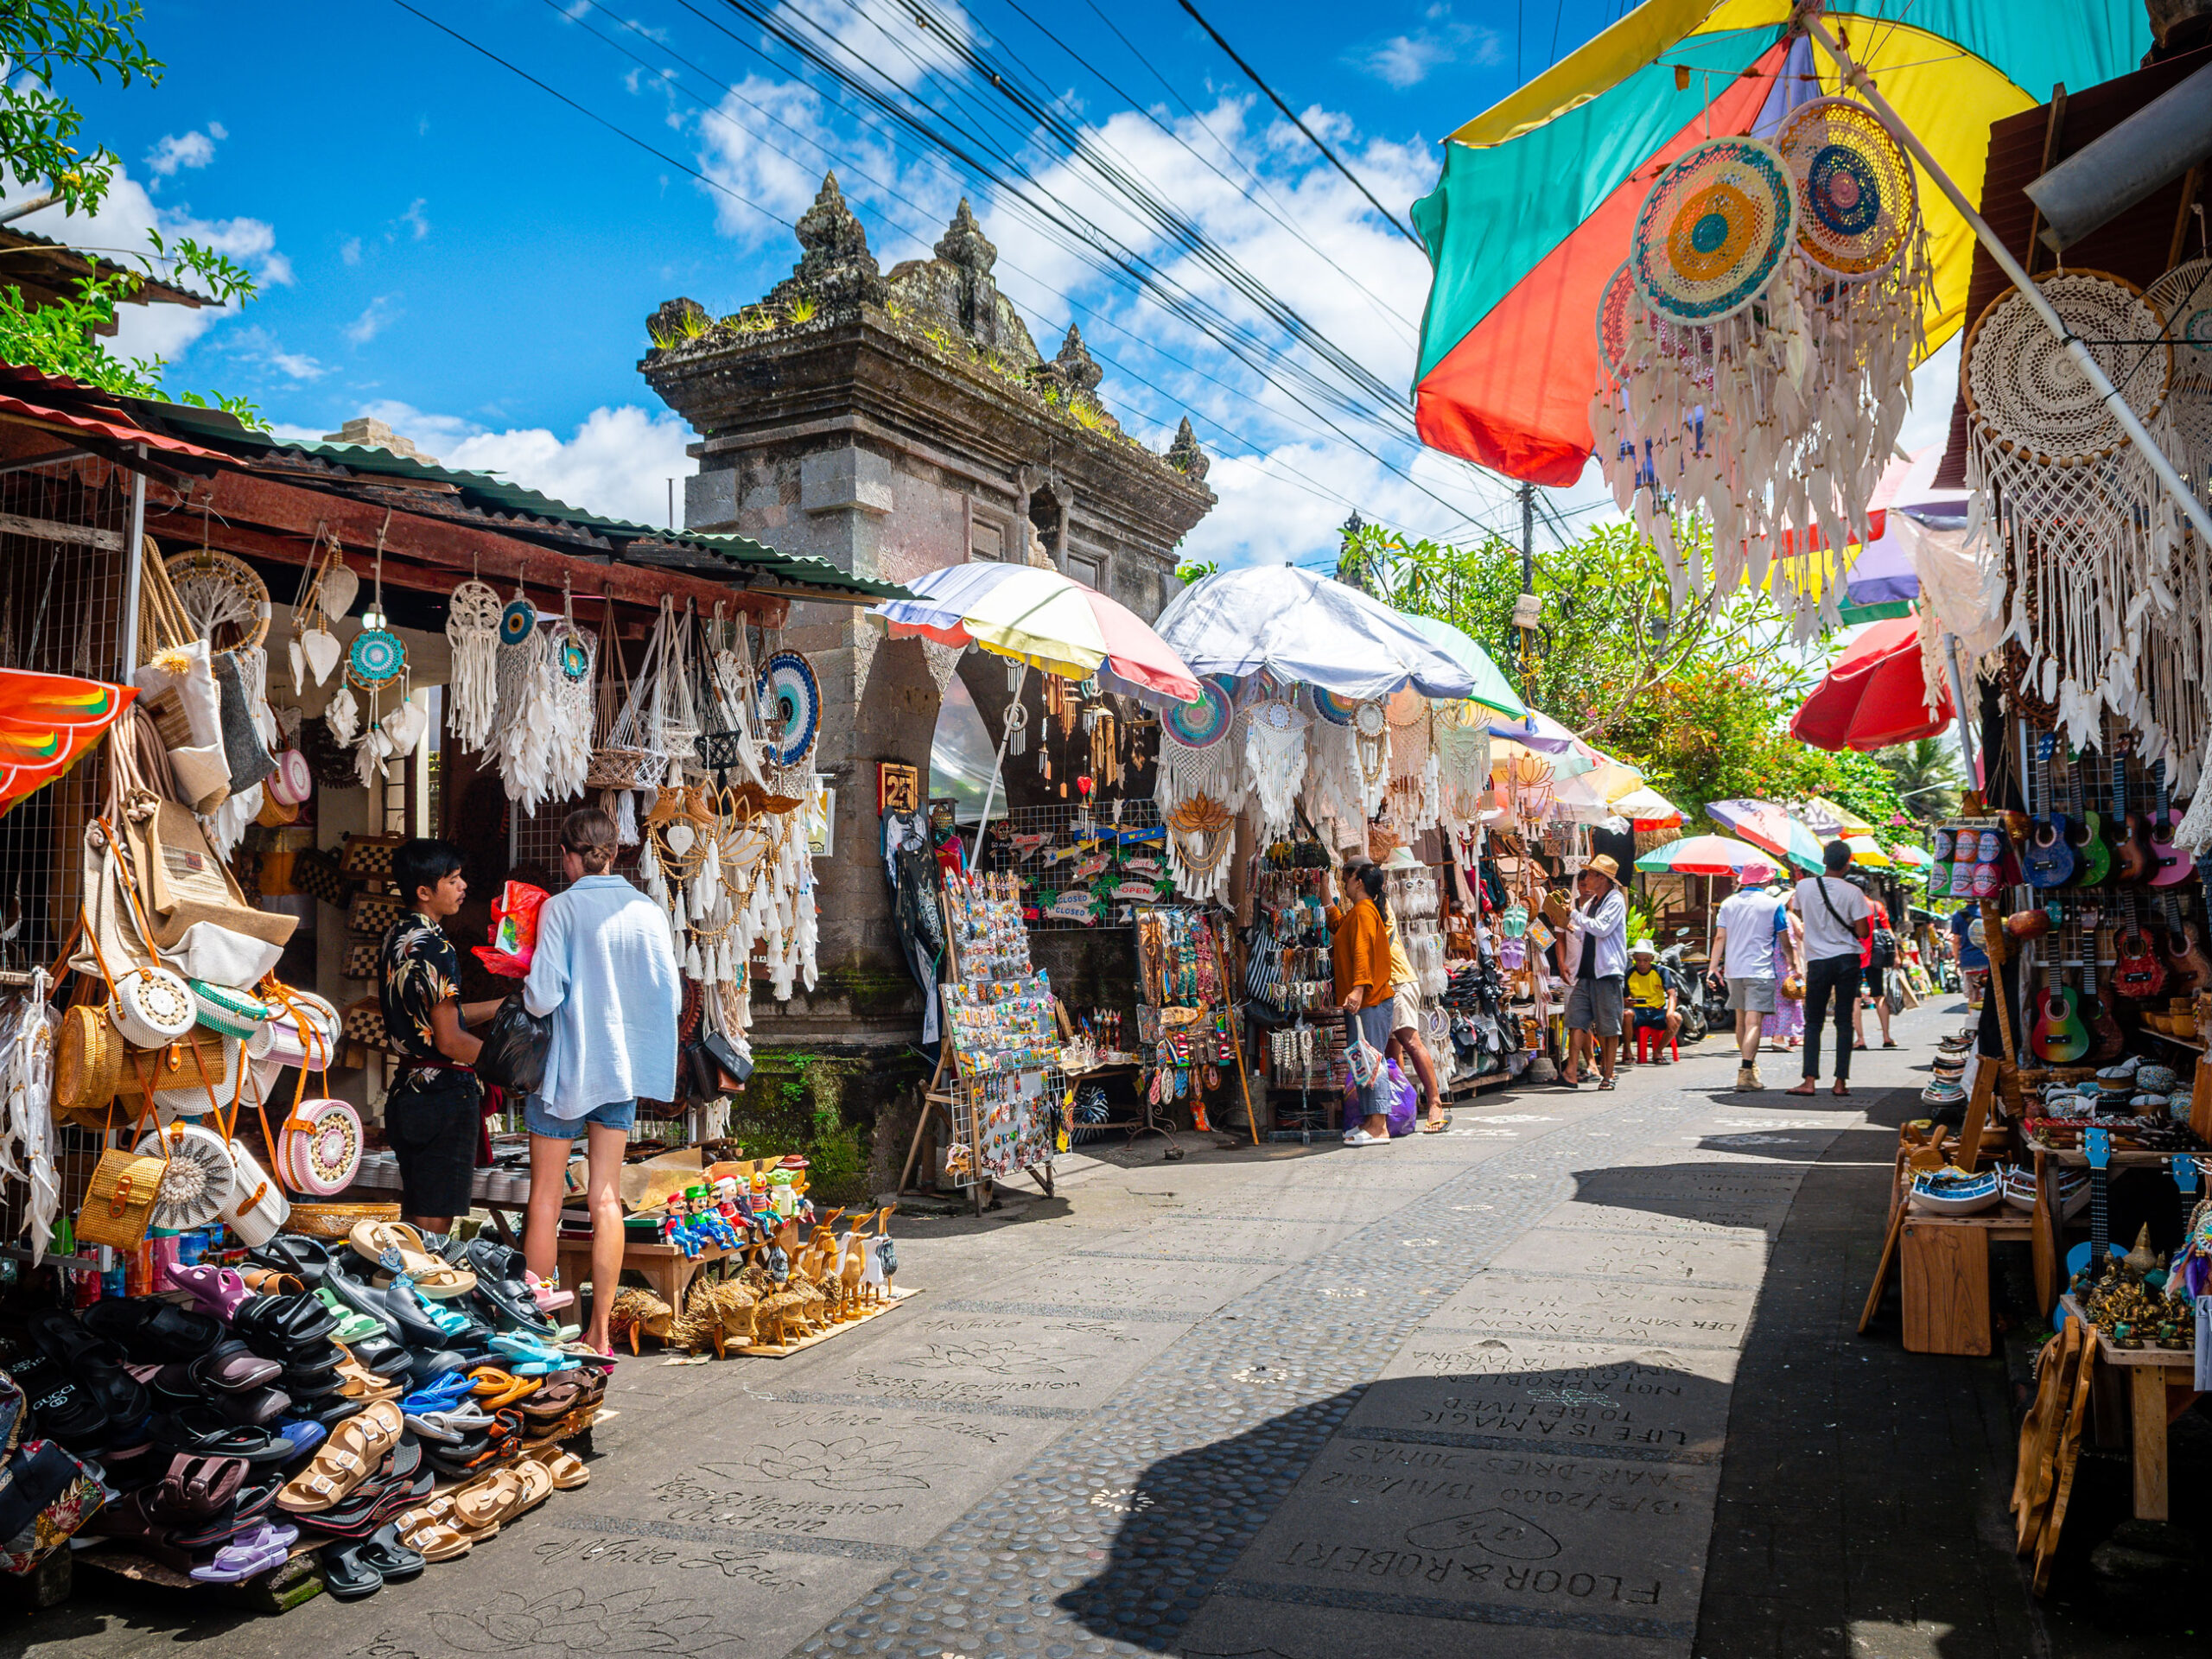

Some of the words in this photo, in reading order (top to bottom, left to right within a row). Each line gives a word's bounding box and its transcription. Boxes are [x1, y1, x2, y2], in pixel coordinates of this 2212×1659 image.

[1122, 887, 1150, 895] OPEN
[1058, 894, 1088, 904] CLOSED
[1055, 906, 1085, 917] CLOSED
[33, 1384, 76, 1410] GUCCI
[1443, 1398, 1537, 1416] LIVED
[1547, 1405, 1588, 1419] BE
[1414, 1409, 1529, 1433] MAGIC
[1600, 1408, 1632, 1423] TO
[1537, 1420, 1559, 1435] A
[1568, 1423, 1597, 1437] IS
[1614, 1426, 1688, 1446] LIFE
